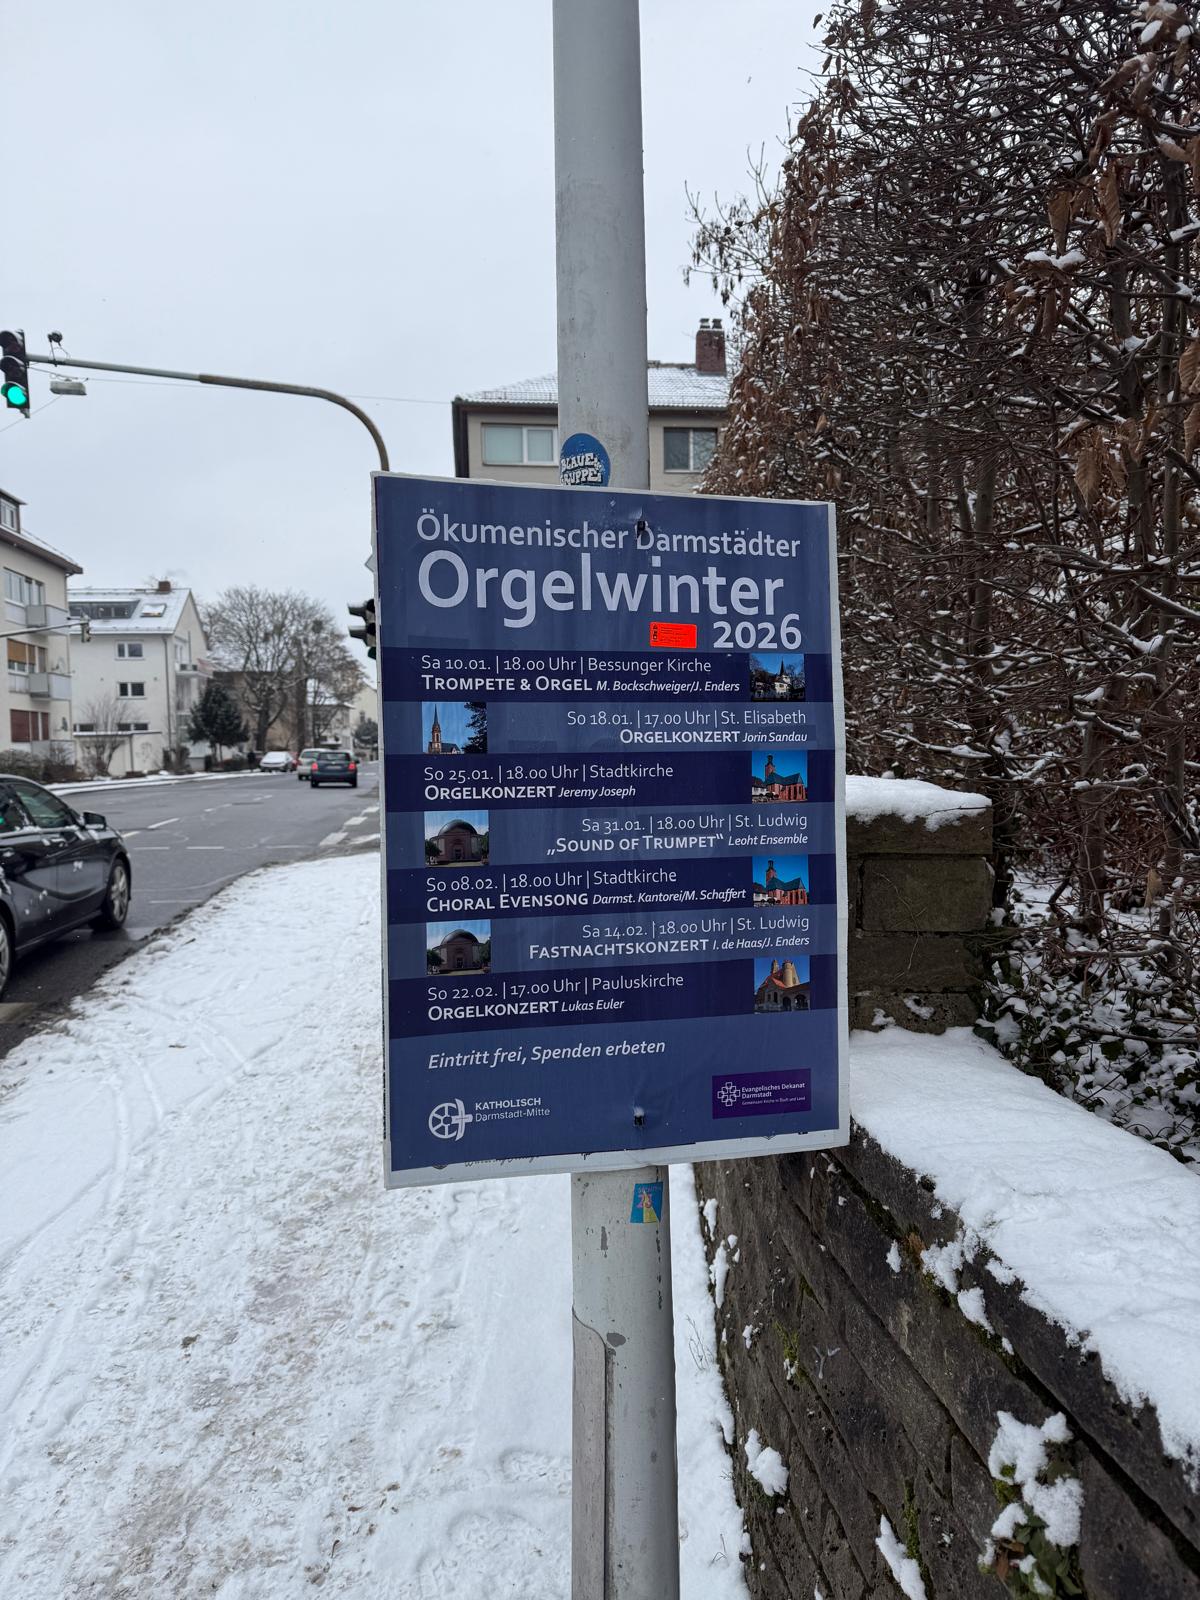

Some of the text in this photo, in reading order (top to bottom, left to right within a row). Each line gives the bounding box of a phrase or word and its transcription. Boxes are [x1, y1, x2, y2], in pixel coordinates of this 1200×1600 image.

[416, 507, 800, 557] Ökumenischer Darmstädter
[418, 550, 784, 628] Orgelwinter
[712, 613, 802, 650] 2026
[421, 654, 441, 670] Sa
[444, 658, 491, 670] 10.01.
[503, 656, 545, 671] 18.00
[548, 656, 577, 671] Uhr
[588, 657, 664, 676] Bessunger
[667, 657, 712, 673] Kirche
[420, 674, 741, 695] TROMPETE & ORGEL M. Bockschweiger/J. Enders
[567, 710, 586, 726] So
[589, 710, 633, 726] 18.01.
[644, 713, 682, 729] 17.00
[684, 709, 711, 725] Uhr
[720, 710, 740, 725] St.
[744, 709, 806, 725] Elisabeth
[619, 728, 808, 744] ORGELKONZERT Jorin Sandau
[423, 766, 444, 781] So
[448, 769, 494, 784] 25.01.
[505, 765, 548, 780] 18.00
[551, 763, 580, 779] Uhr
[589, 762, 674, 779] Stadtkirche
[424, 784, 636, 801] ORGELKONZERT Jeremy Joseph
[581, 818, 600, 832] Sa
[603, 820, 645, 835] 31.01.
[656, 816, 696, 830] 18.00
[698, 814, 725, 829] Uhr
[735, 814, 754, 828] St.
[758, 812, 808, 830] Ludwig
[618, 837, 640, 851] OF
[727, 834, 759, 847] Leoht
[759, 832, 809, 845] Ensemble
[426, 877, 447, 893] So
[450, 875, 498, 891] 08.02.
[510, 873, 552, 889] 18.00
[555, 870, 583, 887] Uhr
[593, 867, 677, 886] Stadtkirche
[426, 887, 747, 913] CHORAL EVENSONG Darmst. Kantorei/M. Schaffert
[582, 924, 601, 939] Sa
[603, 925, 648, 940] 14.02.
[658, 920, 698, 935] 18.00
[701, 917, 728, 933] Uhr
[736, 917, 756, 931] St.
[760, 914, 809, 932] Ludwig
[529, 938, 710, 960] FASTNACHTSKONZERT
[721, 938, 735, 950] de
[735, 936, 774, 950] Haas/J.
[775, 935, 810, 947] Enders
[427, 986, 448, 1002] So
[452, 986, 498, 1000] 22.02.
[510, 983, 550, 999] 17.00
[553, 977, 582, 993] Uhr
[592, 972, 684, 991] Pauluskirche
[427, 997, 625, 1022] ORGELKONZERT Lukas Euler
[428, 1039, 666, 1070] Eintritt frei, Spenden erbeten
[741, 1082, 806, 1094] Evangelisches Dekanat
[741, 1091, 772, 1100] Darmstadt
[475, 1098, 541, 1111] KATHOLISCH
[475, 1108, 551, 1123] Darmstadt-Mitte
